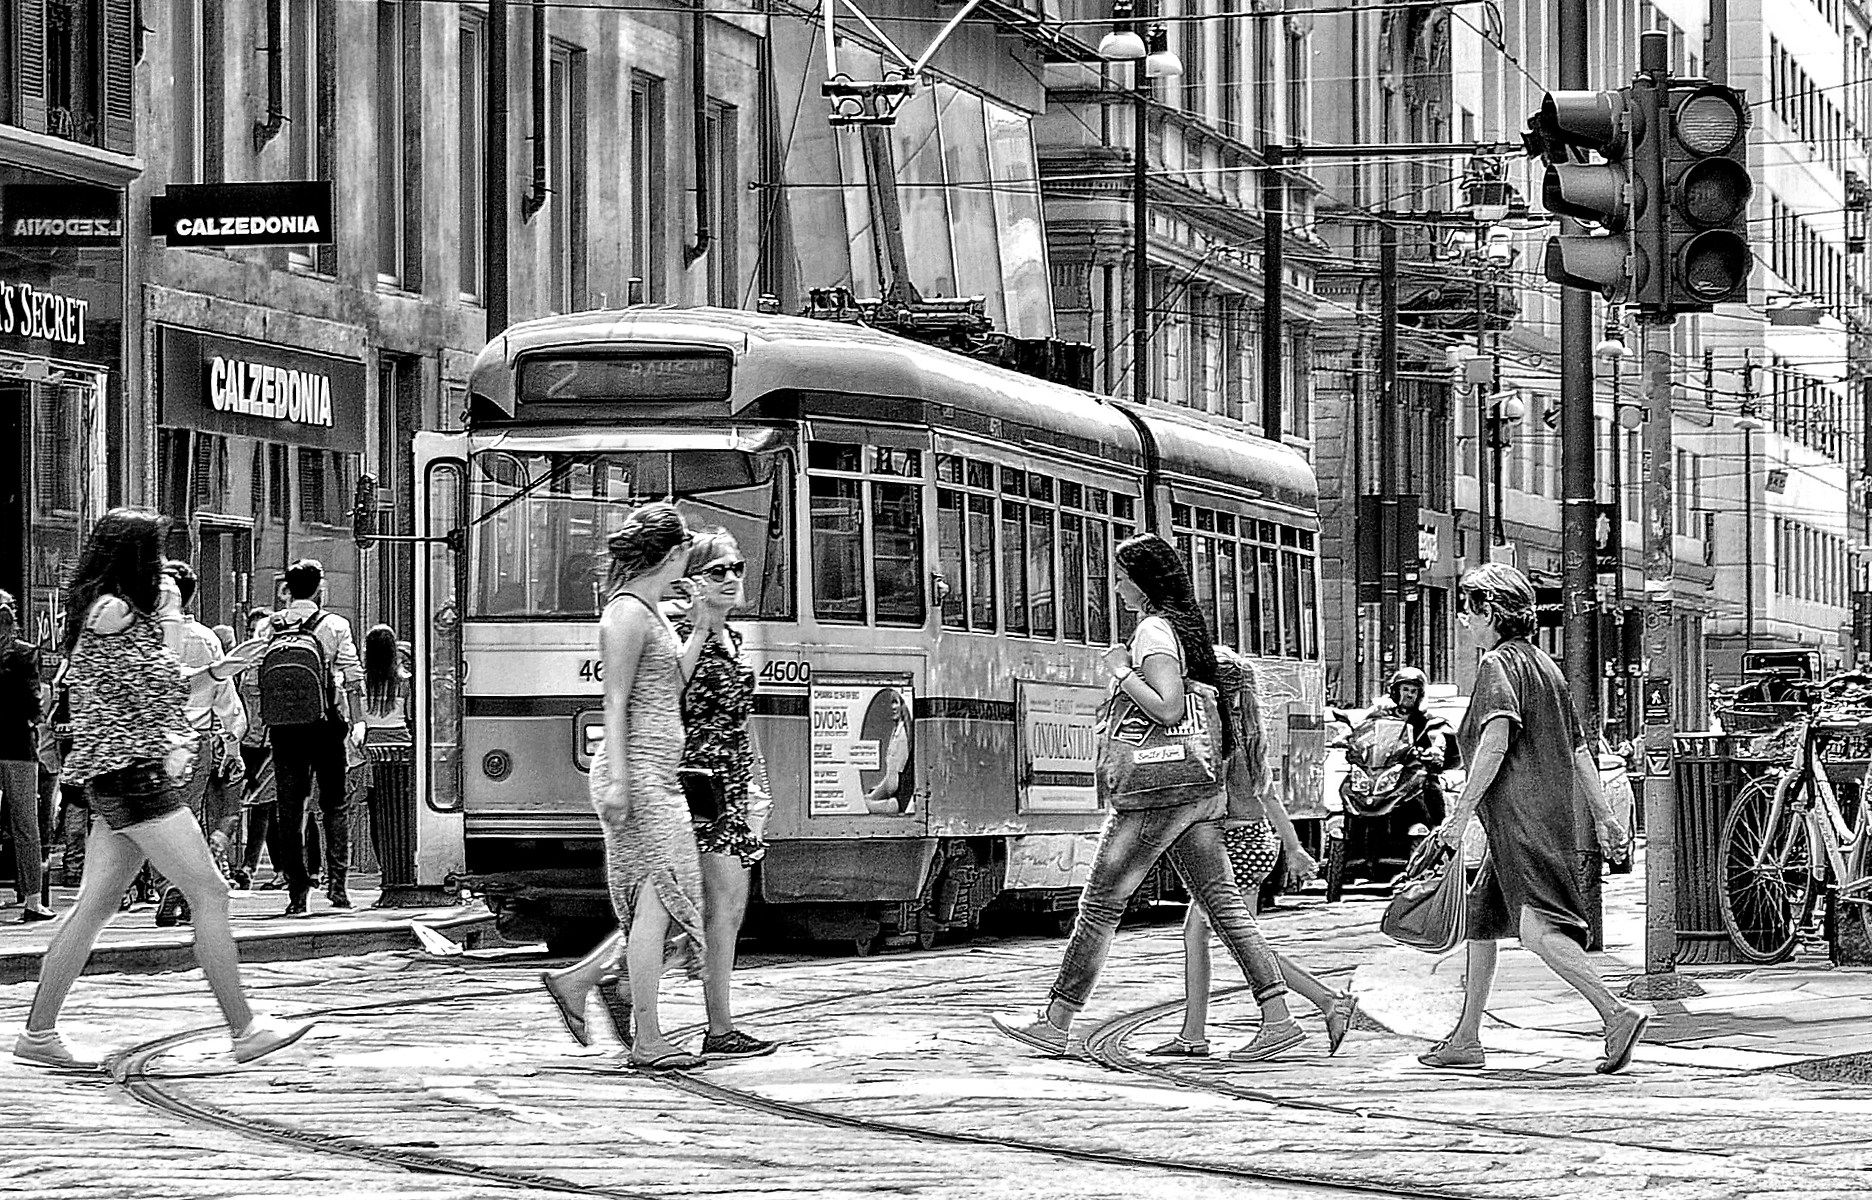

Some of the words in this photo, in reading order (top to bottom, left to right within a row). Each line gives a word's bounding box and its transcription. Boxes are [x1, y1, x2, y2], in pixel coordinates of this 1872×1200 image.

[176, 216, 320, 237] CALZEDONIA
[20, 283, 88, 345] SECRET
[210, 356, 333, 427] CALZEDONIA
[546, 360, 579, 399] 2
[759, 660, 811, 682] 4600
[813, 710, 849, 730] DVORA
